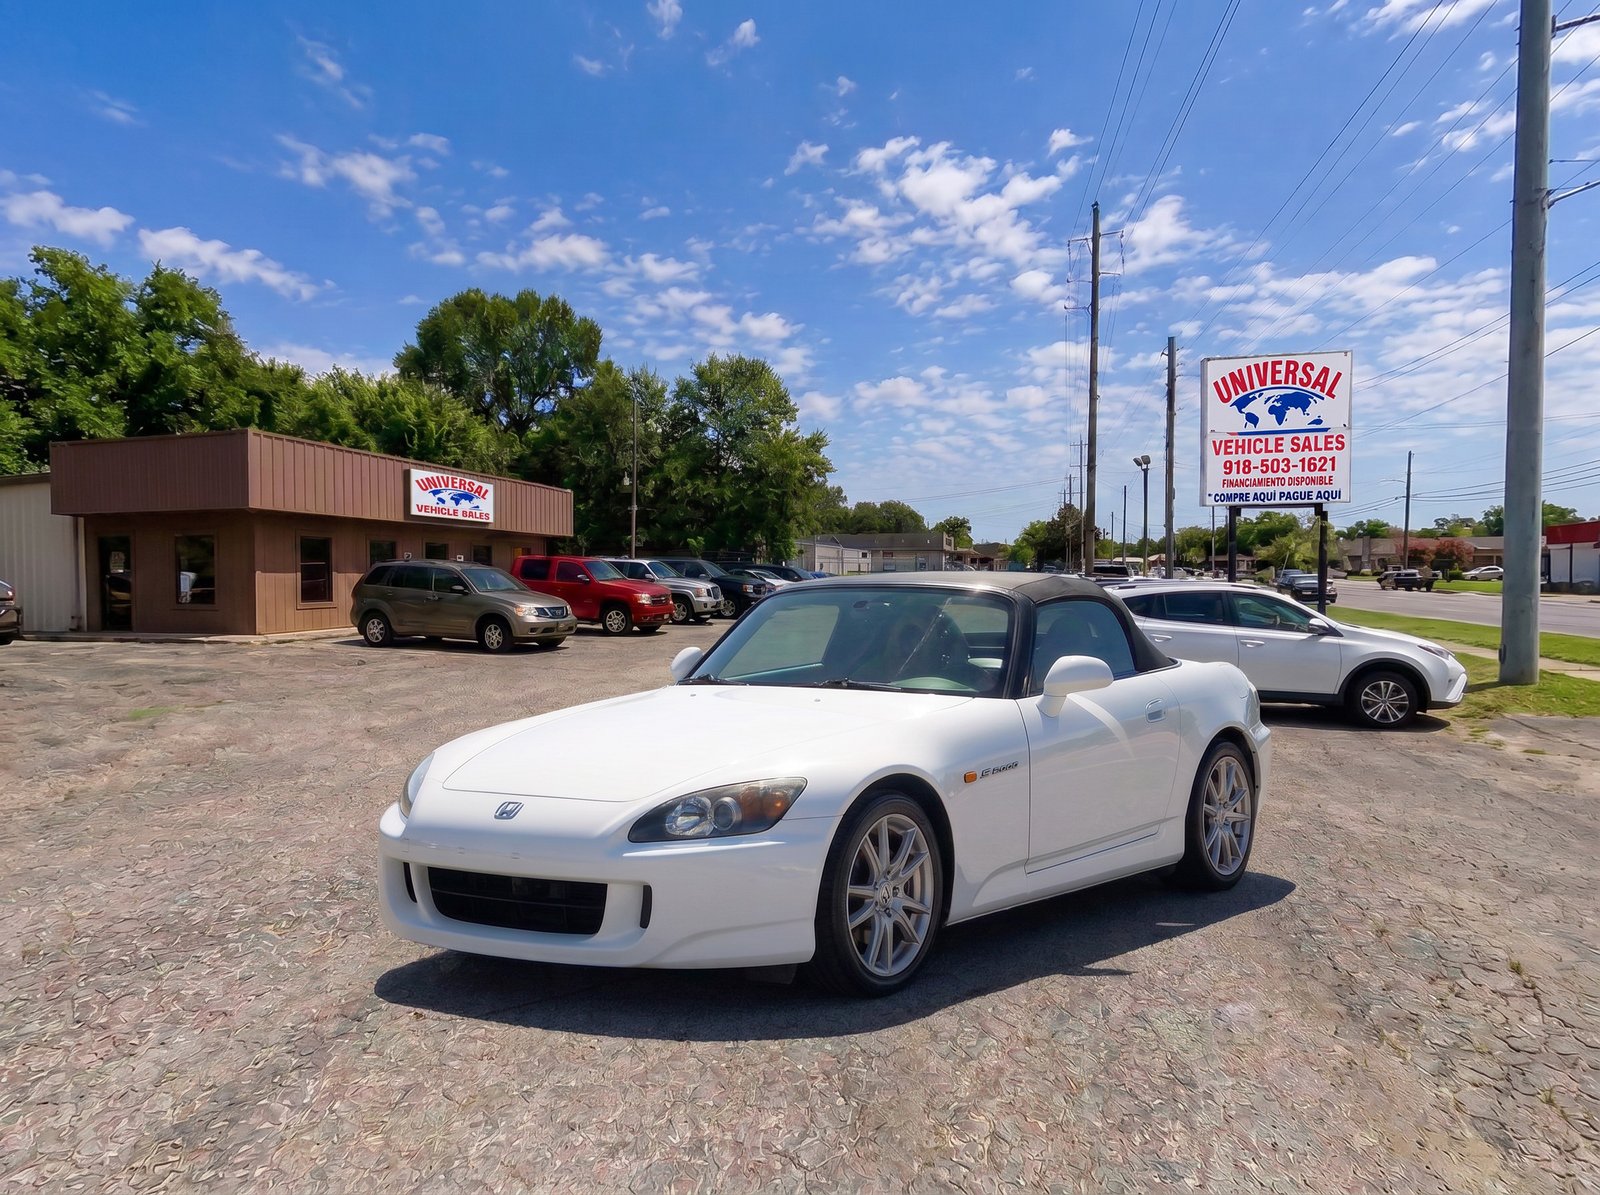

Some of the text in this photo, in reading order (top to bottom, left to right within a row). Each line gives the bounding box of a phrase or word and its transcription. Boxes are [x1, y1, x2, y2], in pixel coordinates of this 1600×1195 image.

[1212, 360, 1343, 404] UNIVERSAL
[1212, 434, 1346, 456] VEHICLE SALES
[1223, 456, 1336, 475] 918-503-1621
[415, 475, 489, 500] UNIVERSAL
[1222, 475, 1334, 489] FINANCIAMIENTO DISPONIBLE
[1213, 492, 1251, 503] COMPRE
[1279, 490, 1313, 501] PAGUE
[416, 503, 490, 521] VEHICLE SALES
